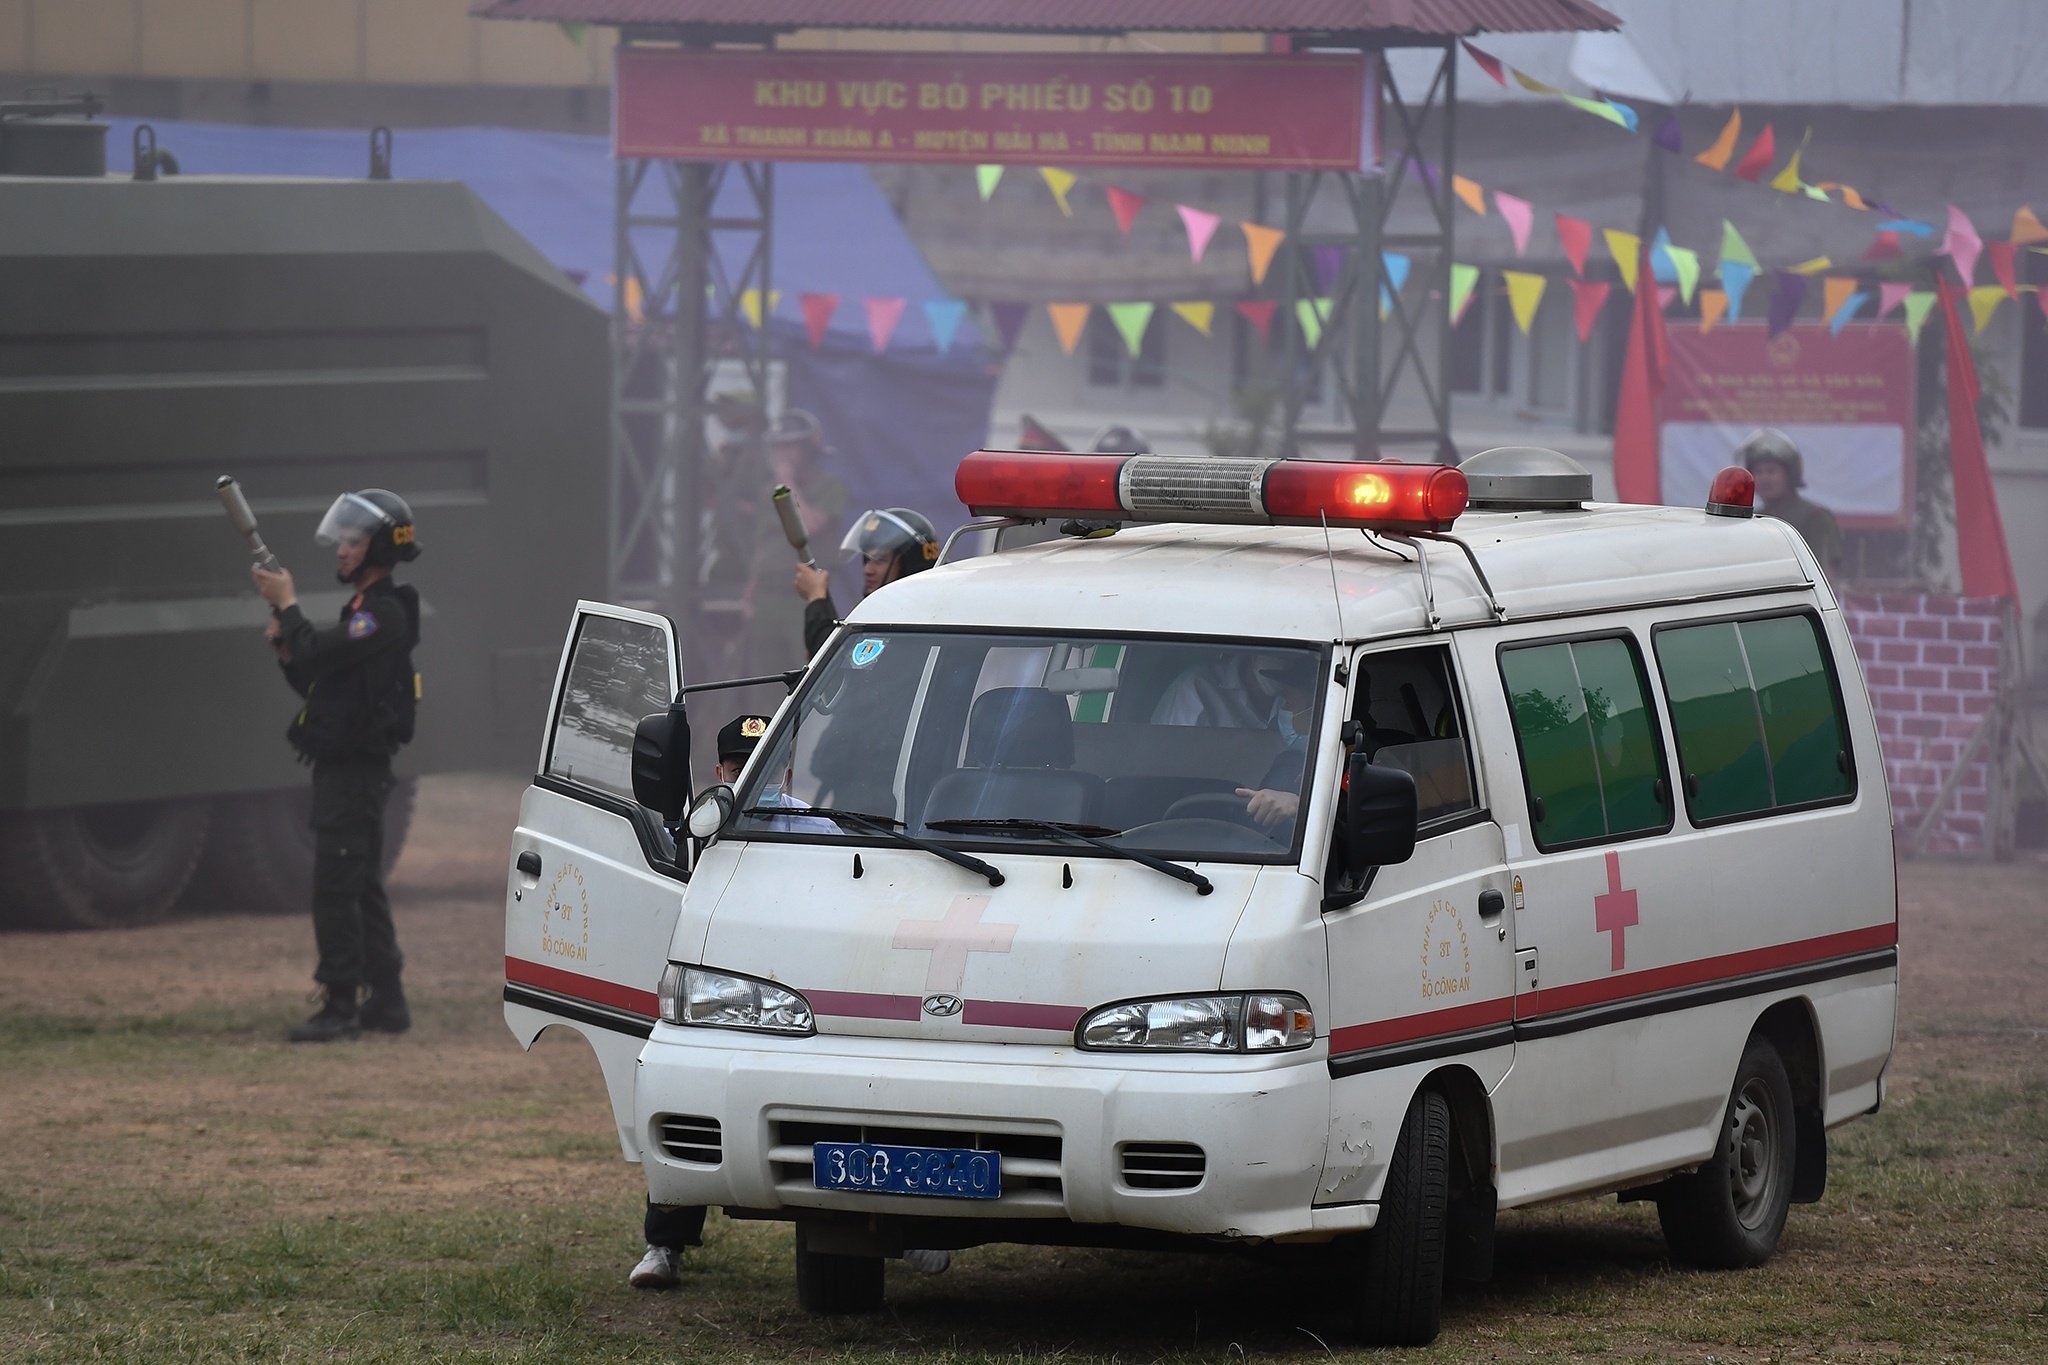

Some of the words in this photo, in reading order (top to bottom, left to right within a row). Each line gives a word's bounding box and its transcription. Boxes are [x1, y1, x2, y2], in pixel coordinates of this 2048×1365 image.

[755, 79, 826, 109] KHU
[838, 78, 908, 116] VỰC
[919, 73, 969, 110] BỎ
[980, 74, 1091, 111] PHIẾU
[1104, 75, 1154, 112] SỐ
[1169, 84, 1213, 113] 10
[543, 935, 552, 956] BỘ
[554, 938, 576, 958] CÔNG
[577, 946, 588, 961] AN
[1440, 941, 1451, 958] 3T
[1422, 979, 1433, 1001] BỘ
[1434, 977, 1457, 995] CÔNG
[1459, 976, 1470, 991] AN
